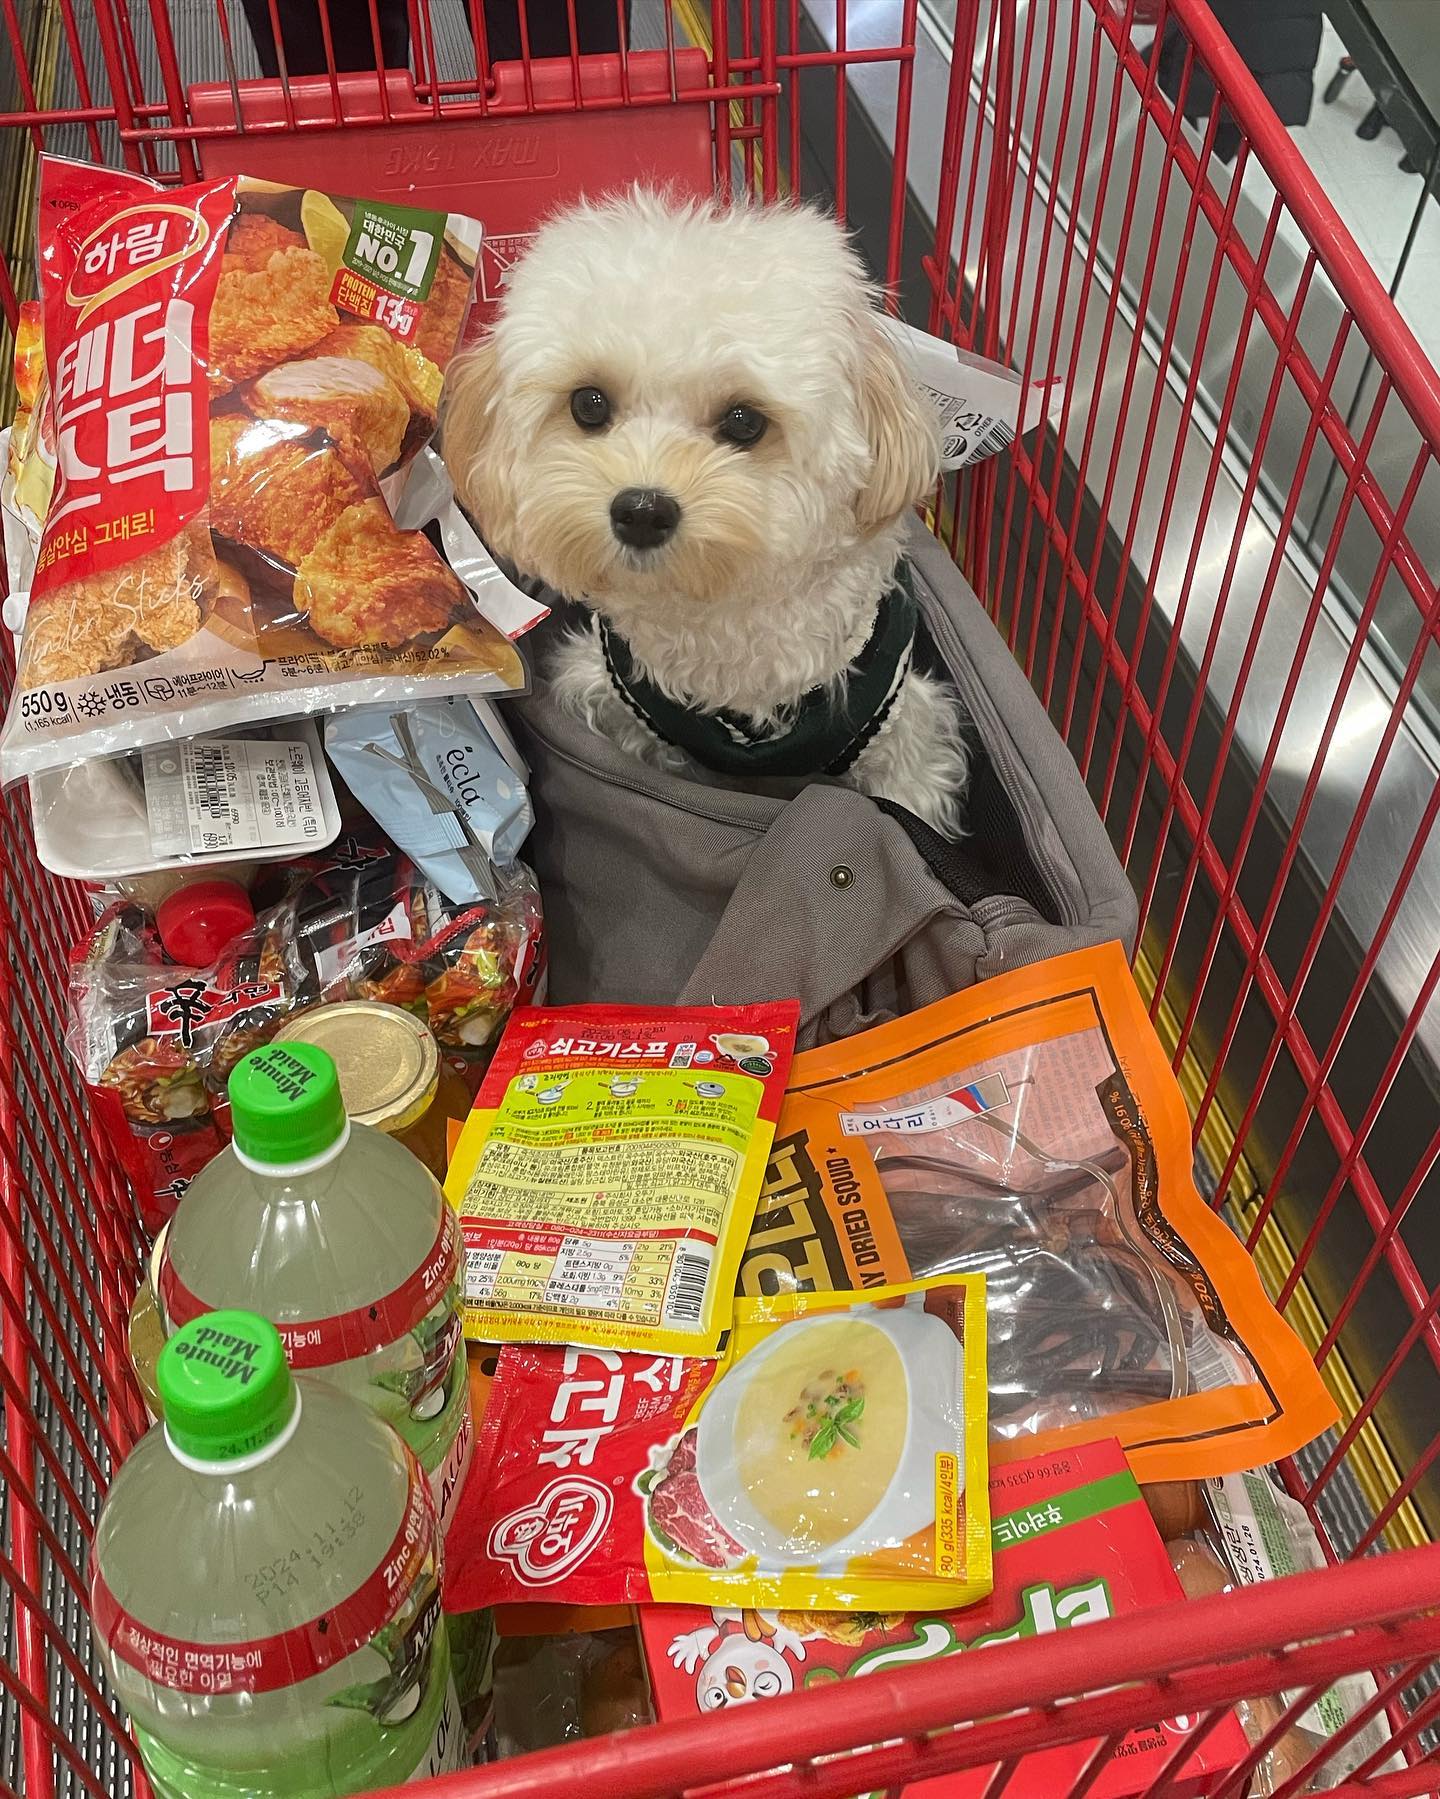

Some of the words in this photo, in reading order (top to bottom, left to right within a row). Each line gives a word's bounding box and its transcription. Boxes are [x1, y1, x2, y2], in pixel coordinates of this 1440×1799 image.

[58, 201, 81, 211] OPEN
[84, 219, 169, 275] 하림
[363, 219, 406, 251] 대한민국
[355, 229, 434, 288] NO.1
[337, 286, 373, 318] 단백질
[342, 272, 377, 301] PROTEIN
[974, 416, 994, 437] OTHER
[94, 508, 156, 545] 그대로!
[112, 566, 210, 641] Sticks
[172, 666, 225, 688] 에어프라이어
[177, 681, 229, 698] 11분~12분
[21, 690, 51, 718] 550
[53, 691, 68, 713] g
[105, 681, 140, 710] 냉동
[24, 716, 49, 733] (1,165
[51, 713, 73, 728] kcal)
[288, 746, 305, 774] 노르웨이
[294, 778, 313, 813] 고등어자반
[549, 1038, 669, 1058] 쇠고기스프
[249, 1056, 308, 1101] Minute
[270, 1049, 318, 1085] Maid
[863, 1111, 926, 1132] 오다리
[826, 1156, 862, 1207] SQUID
[463, 1231, 482, 1243] 정보
[843, 1207, 881, 1263] DRIED
[422, 1254, 446, 1291] Zinc
[515, 1260, 531, 1269] 80g
[478, 1287, 491, 1297] 4%
[493, 1288, 508, 1299] 56g
[1193, 1280, 1214, 1312] 130
[196, 1327, 263, 1361] Maid
[281, 1329, 321, 1348] 기능에
[175, 1341, 260, 1385] Minute
[633, 1357, 684, 1392] 스
[635, 1396, 650, 1420] BEEF
[540, 1494, 589, 1556] 오뚜기
[940, 1517, 955, 1551] g(335
[989, 1501, 1064, 1543] 후라이드
[384, 1545, 411, 1589] Zinc
[940, 1554, 953, 1574] 80
[1241, 1524, 1265, 1582] 024.01.28
[127, 1626, 182, 1671] 정상적인
[183, 1648, 262, 1673] 면역기능에
[430, 1702, 460, 1777] LOE
[1109, 1742, 1137, 1759] 맛있
